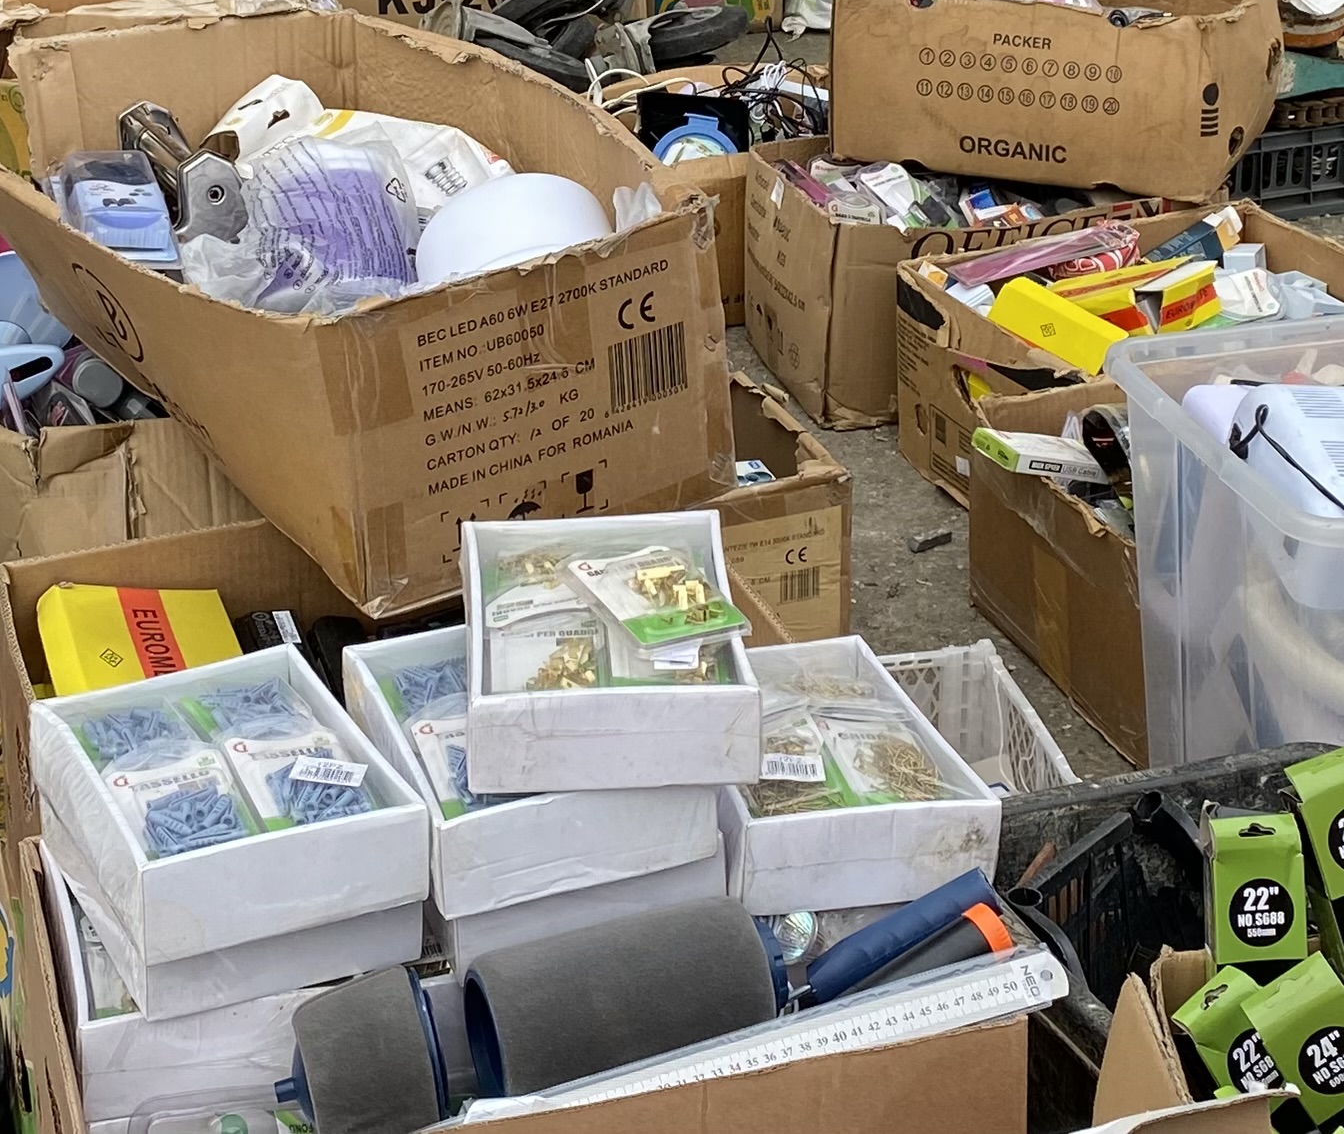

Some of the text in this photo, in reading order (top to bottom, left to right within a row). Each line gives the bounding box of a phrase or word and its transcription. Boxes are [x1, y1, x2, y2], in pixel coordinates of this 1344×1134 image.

[993, 33, 1052, 50] PACKER
[959, 135, 1067, 164] ORGANIC
[417, 259, 670, 347] BEC LED A60 6W E27 2700K STANDARD
[419, 353, 454, 372] ITEM
[421, 352, 541, 397] 170-265V 50-60Hz
[574, 357, 596, 375] CM
[559, 388, 579, 404] KG
[426, 442, 486, 471] CARTON
[551, 416, 570, 432] OF
[580, 407, 595, 423] 20
[427, 419, 634, 497] MADE IN CHINA FOR ROMANIA
[1243, 886, 1279, 912] 22"
[1020, 965, 1040, 997] NEO
[729, 1062, 742, 1073] 34
[746, 1057, 759, 1068] 35
[764, 1052, 777, 1063] 36
[782, 1046, 793, 1058] 37
[799, 1041, 812, 1052] 38
[816, 1036, 828, 1048] 39
[832, 1031, 847, 1043] 40
[851, 1026, 864, 1037] 41
[868, 1021, 881, 1032] 42
[885, 1016, 898, 1027] 43
[903, 1011, 915, 1022] 44
[920, 1006, 932, 1017] 45
[936, 1001, 949, 1012] 46
[954, 996, 966, 1008] 47
[970, 991, 983, 1002] 48
[987, 986, 999, 998] 49
[1003, 981, 1018, 994] 50
[1306, 1030, 1341, 1067] 24"
